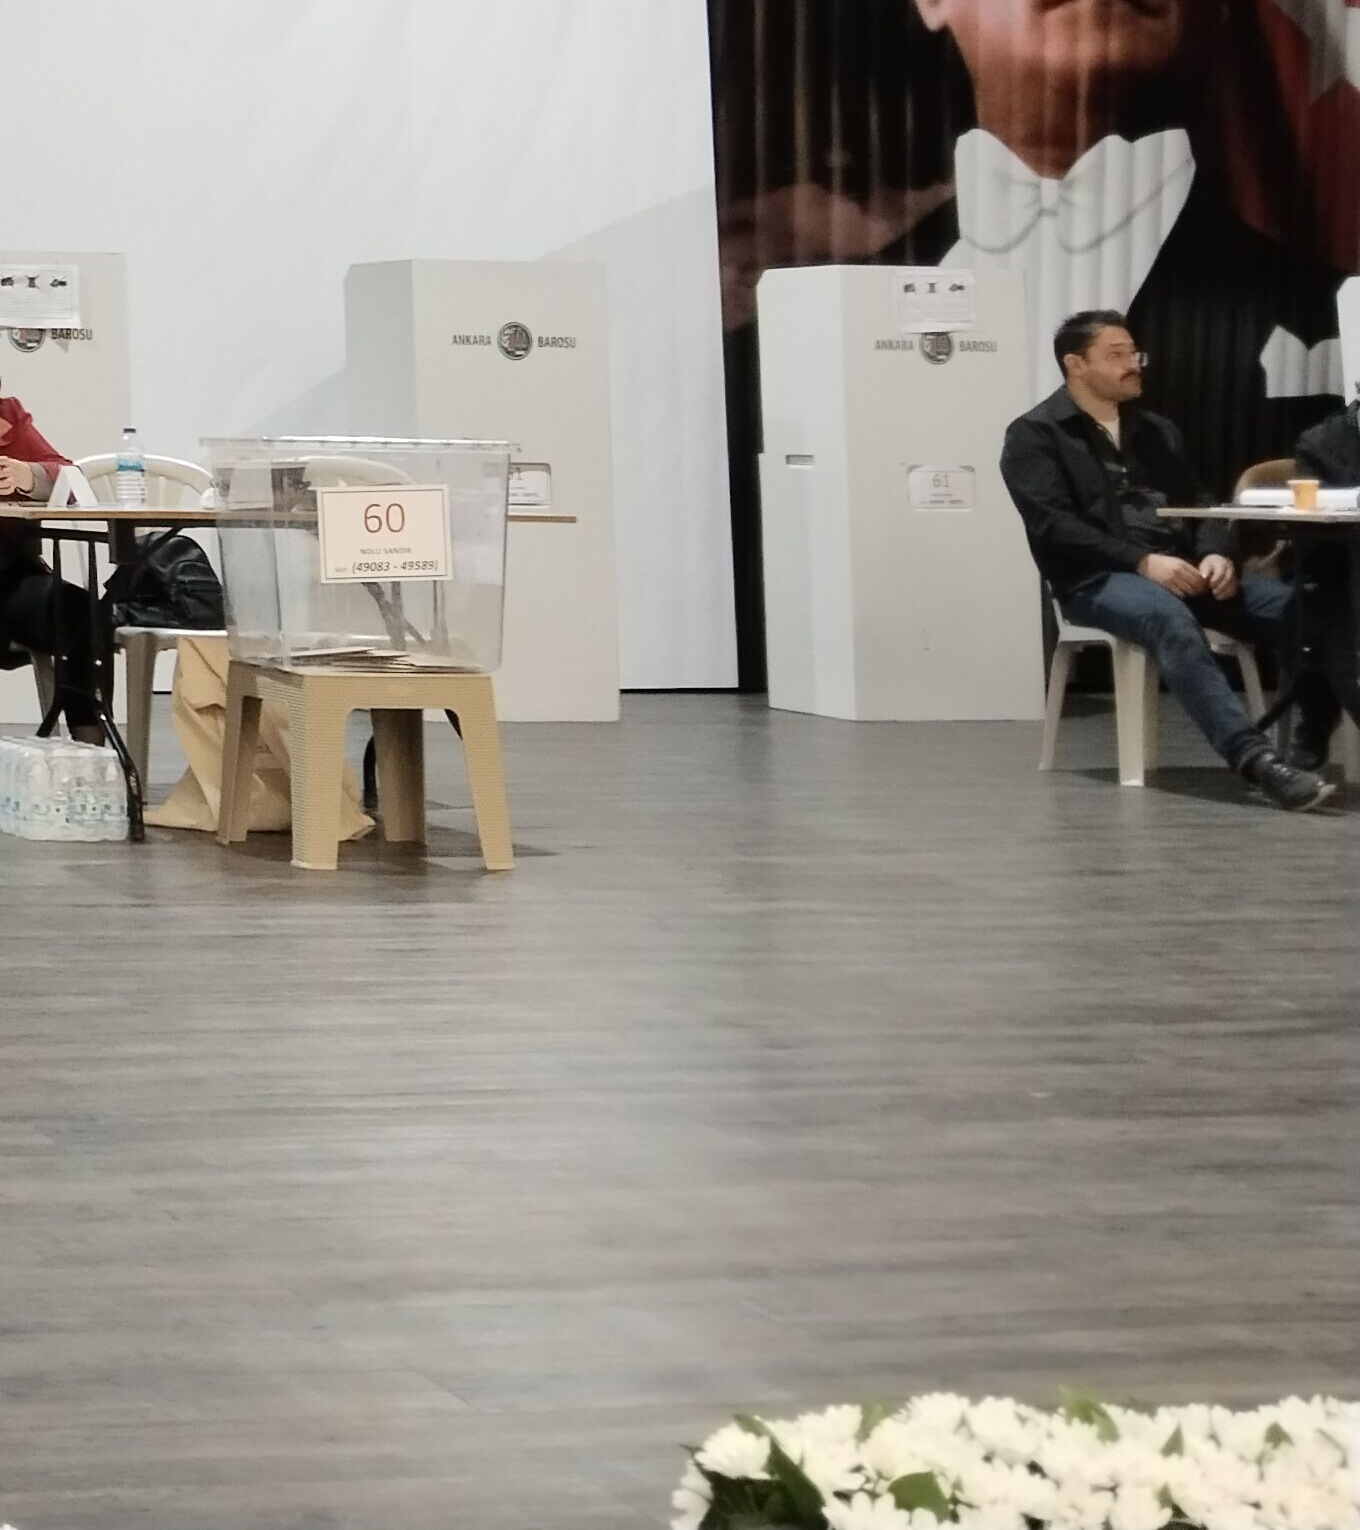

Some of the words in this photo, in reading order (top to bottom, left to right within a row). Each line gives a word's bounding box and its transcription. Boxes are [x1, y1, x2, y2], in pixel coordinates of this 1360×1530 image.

[51, 328, 93, 340] BAROSU
[452, 334, 492, 346] ANKARA
[537, 336, 576, 348] BAROSU
[960, 340, 997, 352] BAROSU
[932, 473, 950, 488] 61
[364, 503, 405, 533] 60
